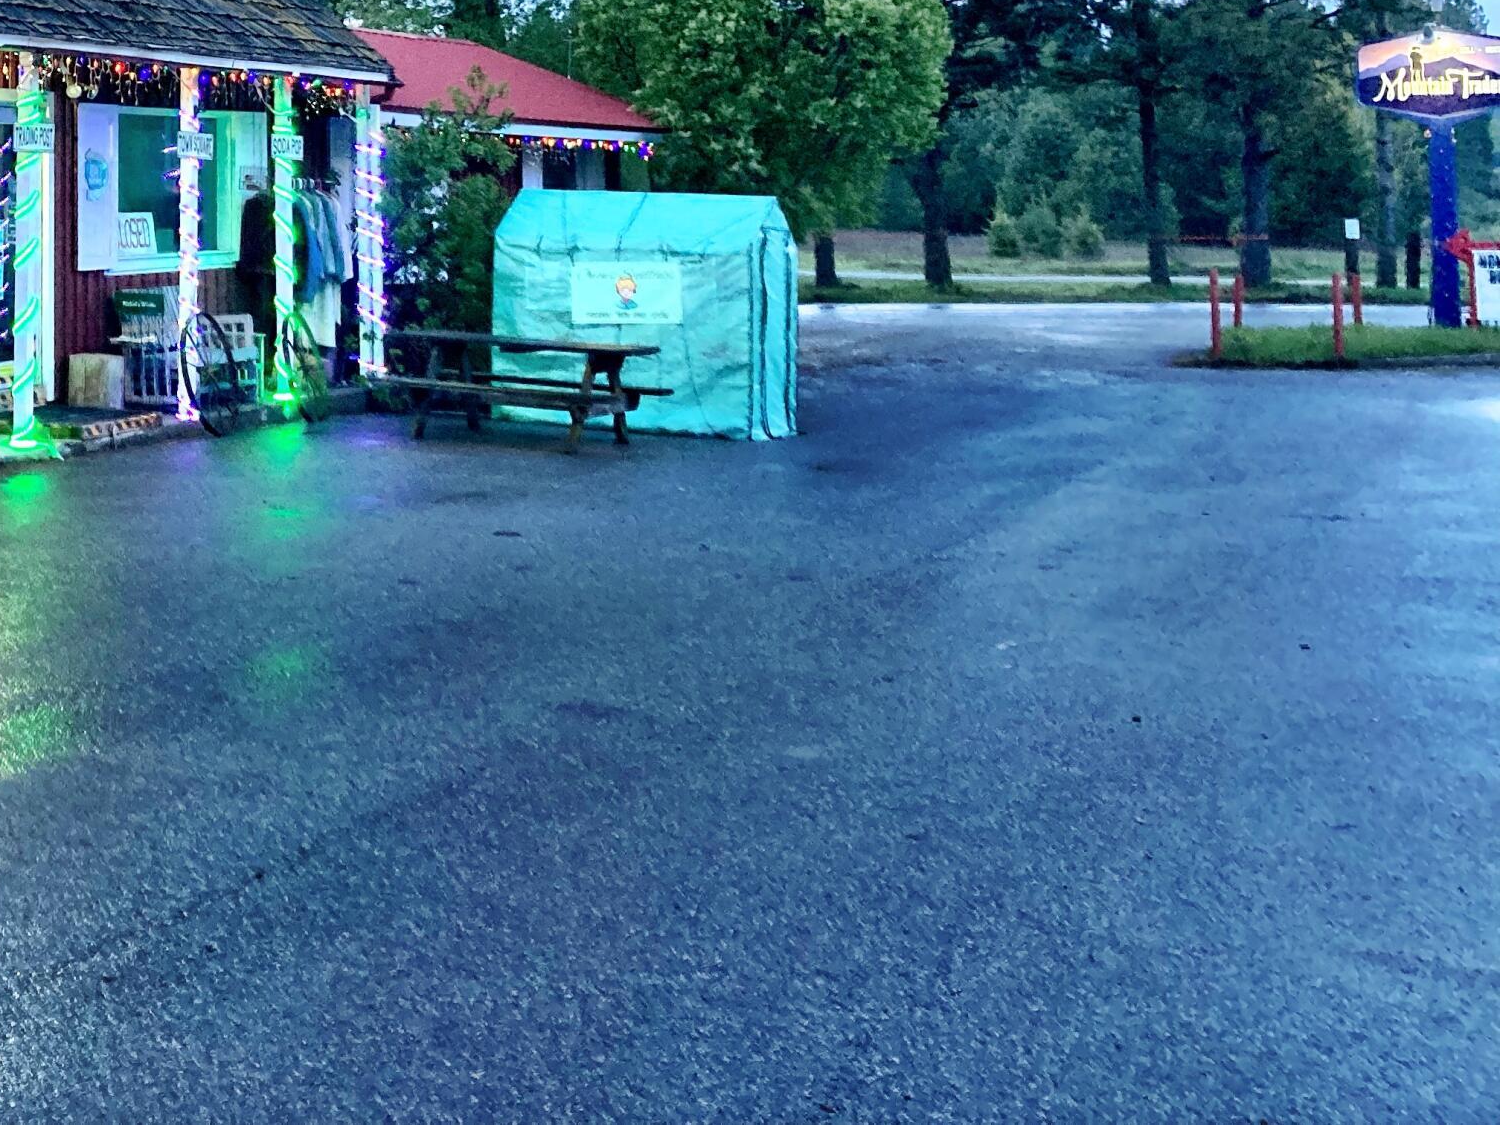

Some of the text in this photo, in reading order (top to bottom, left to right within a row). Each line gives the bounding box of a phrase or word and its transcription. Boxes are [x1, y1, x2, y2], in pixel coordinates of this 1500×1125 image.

[15, 126, 53, 147] TRADING POST
[273, 137, 289, 155] SODA
[118, 218, 151, 249] LOSED
